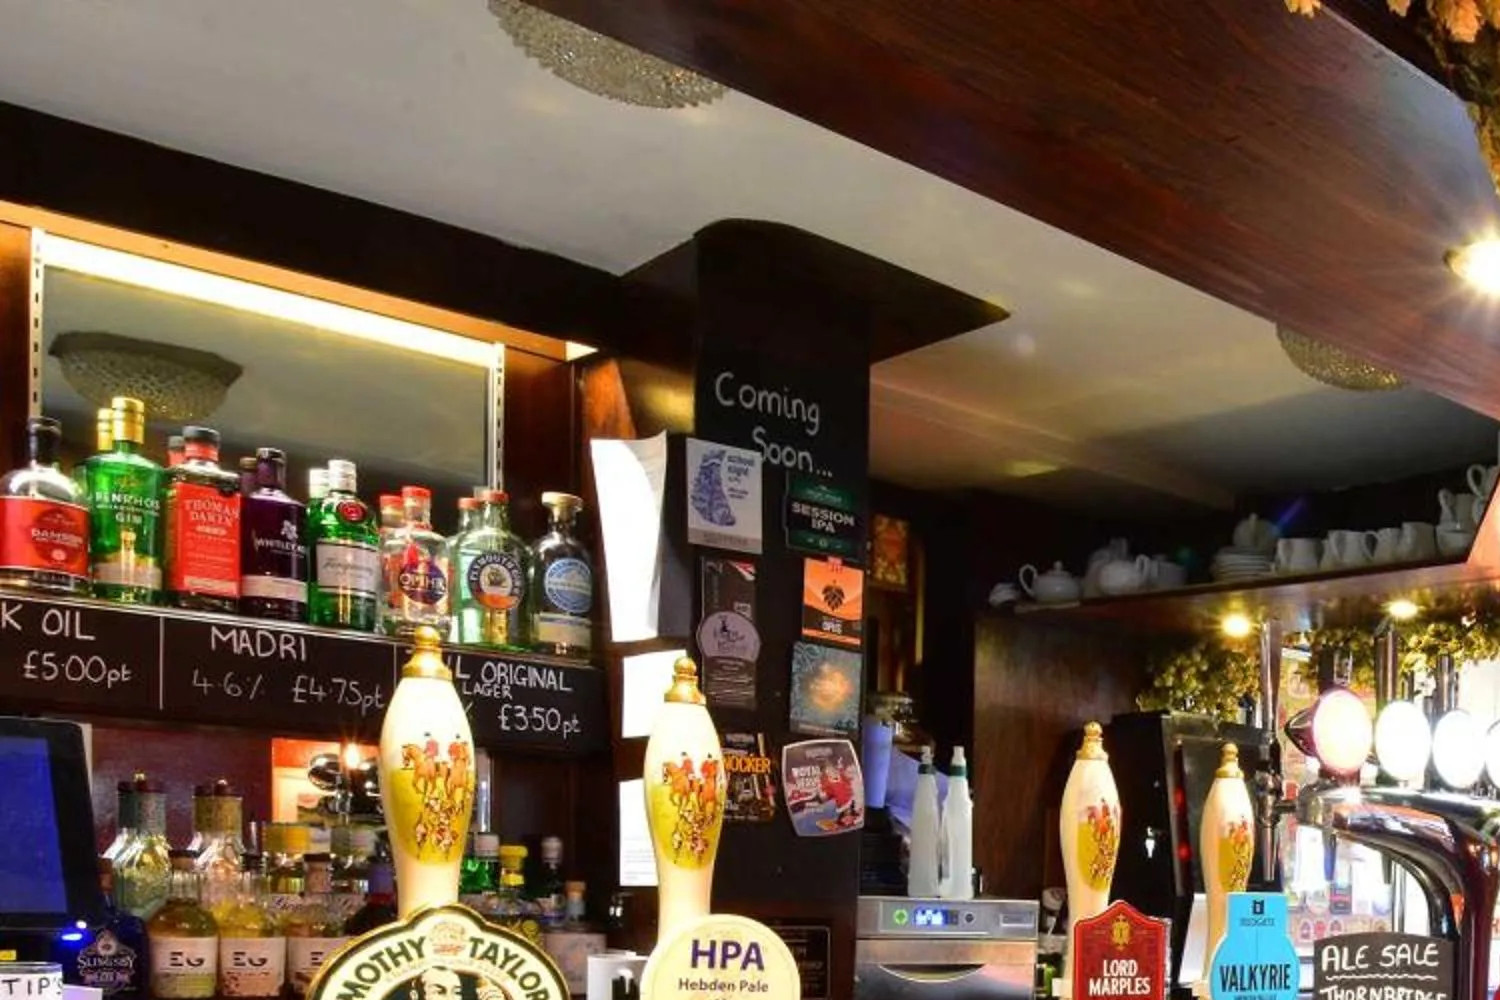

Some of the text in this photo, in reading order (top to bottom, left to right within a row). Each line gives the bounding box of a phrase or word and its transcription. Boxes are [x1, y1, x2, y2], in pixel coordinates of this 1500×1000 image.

[715, 372, 820, 436] Coming
[791, 501, 855, 526] SESSION
[811, 518, 836, 533] IPA
[42, 609, 95, 640] OIL
[211, 626, 306, 661] MADRI
[462, 682, 513, 699] LAGER
[481, 661, 573, 692] ORIGINAL
[691, 939, 764, 971] HPA
[1103, 960, 1138, 978] LORD
[1321, 943, 1440, 971] ALE SALE
[678, 978, 769, 993] Hebden Pale
[1089, 977, 1150, 996] MARPLES
[1220, 964, 1291, 992] VALKYRIE
